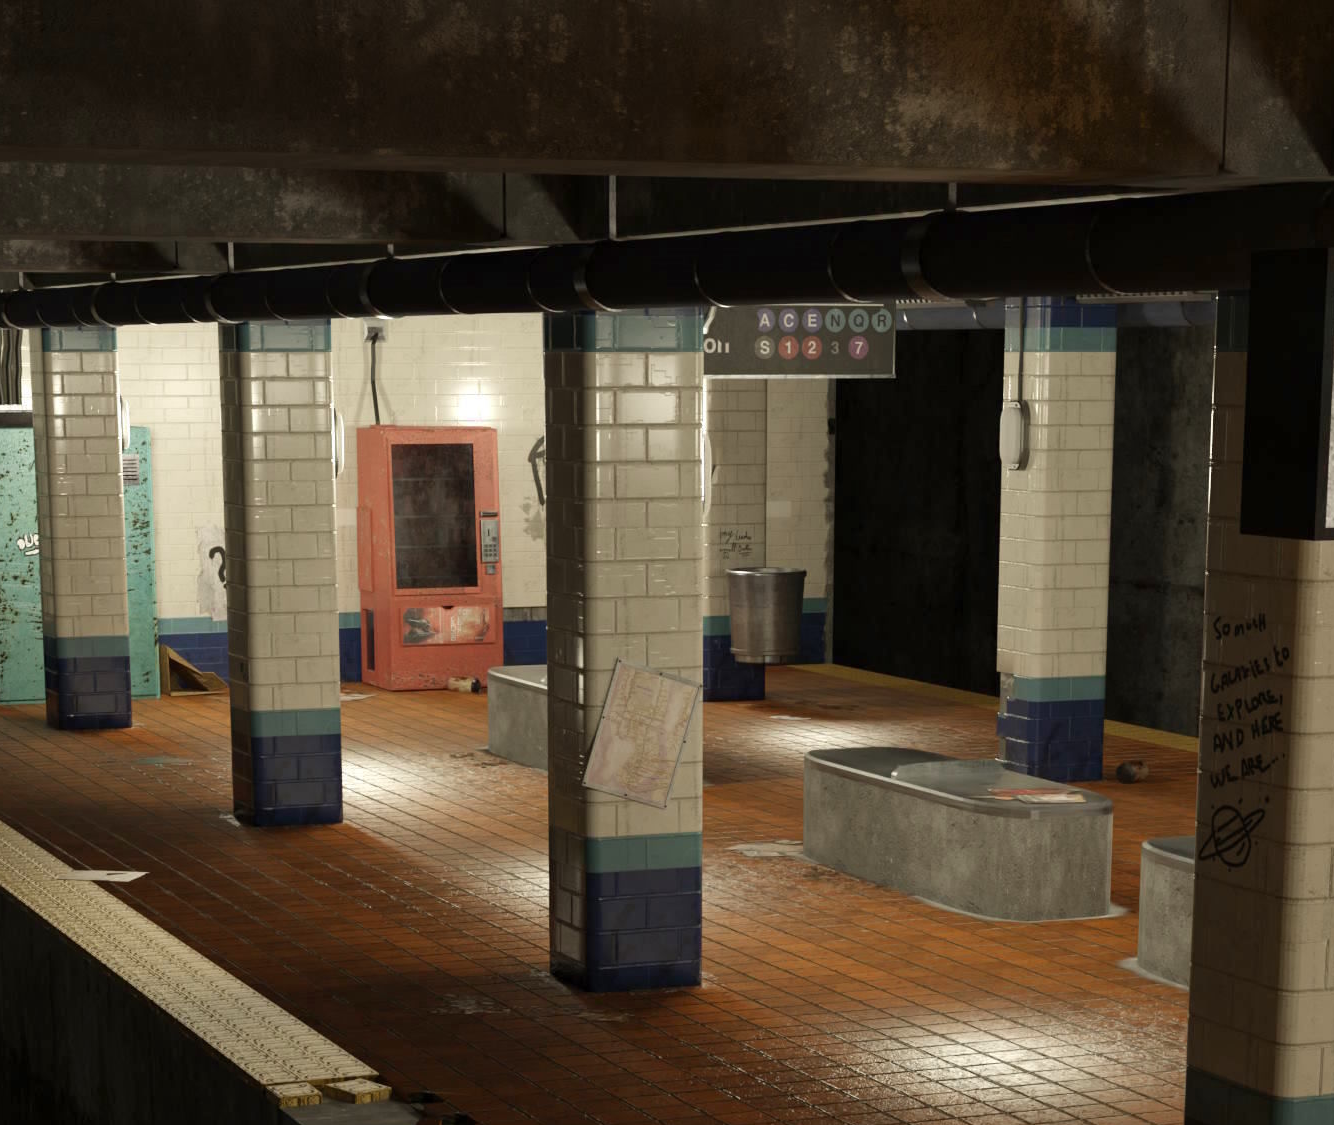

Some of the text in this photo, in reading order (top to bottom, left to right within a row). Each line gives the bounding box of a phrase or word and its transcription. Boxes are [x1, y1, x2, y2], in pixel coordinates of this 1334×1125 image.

[759, 312, 887, 328] A C E N Q R
[759, 341, 865, 355] S 1 2 3 7
[1213, 711, 1284, 753] AND HERE
[1210, 764, 1239, 789] WE
